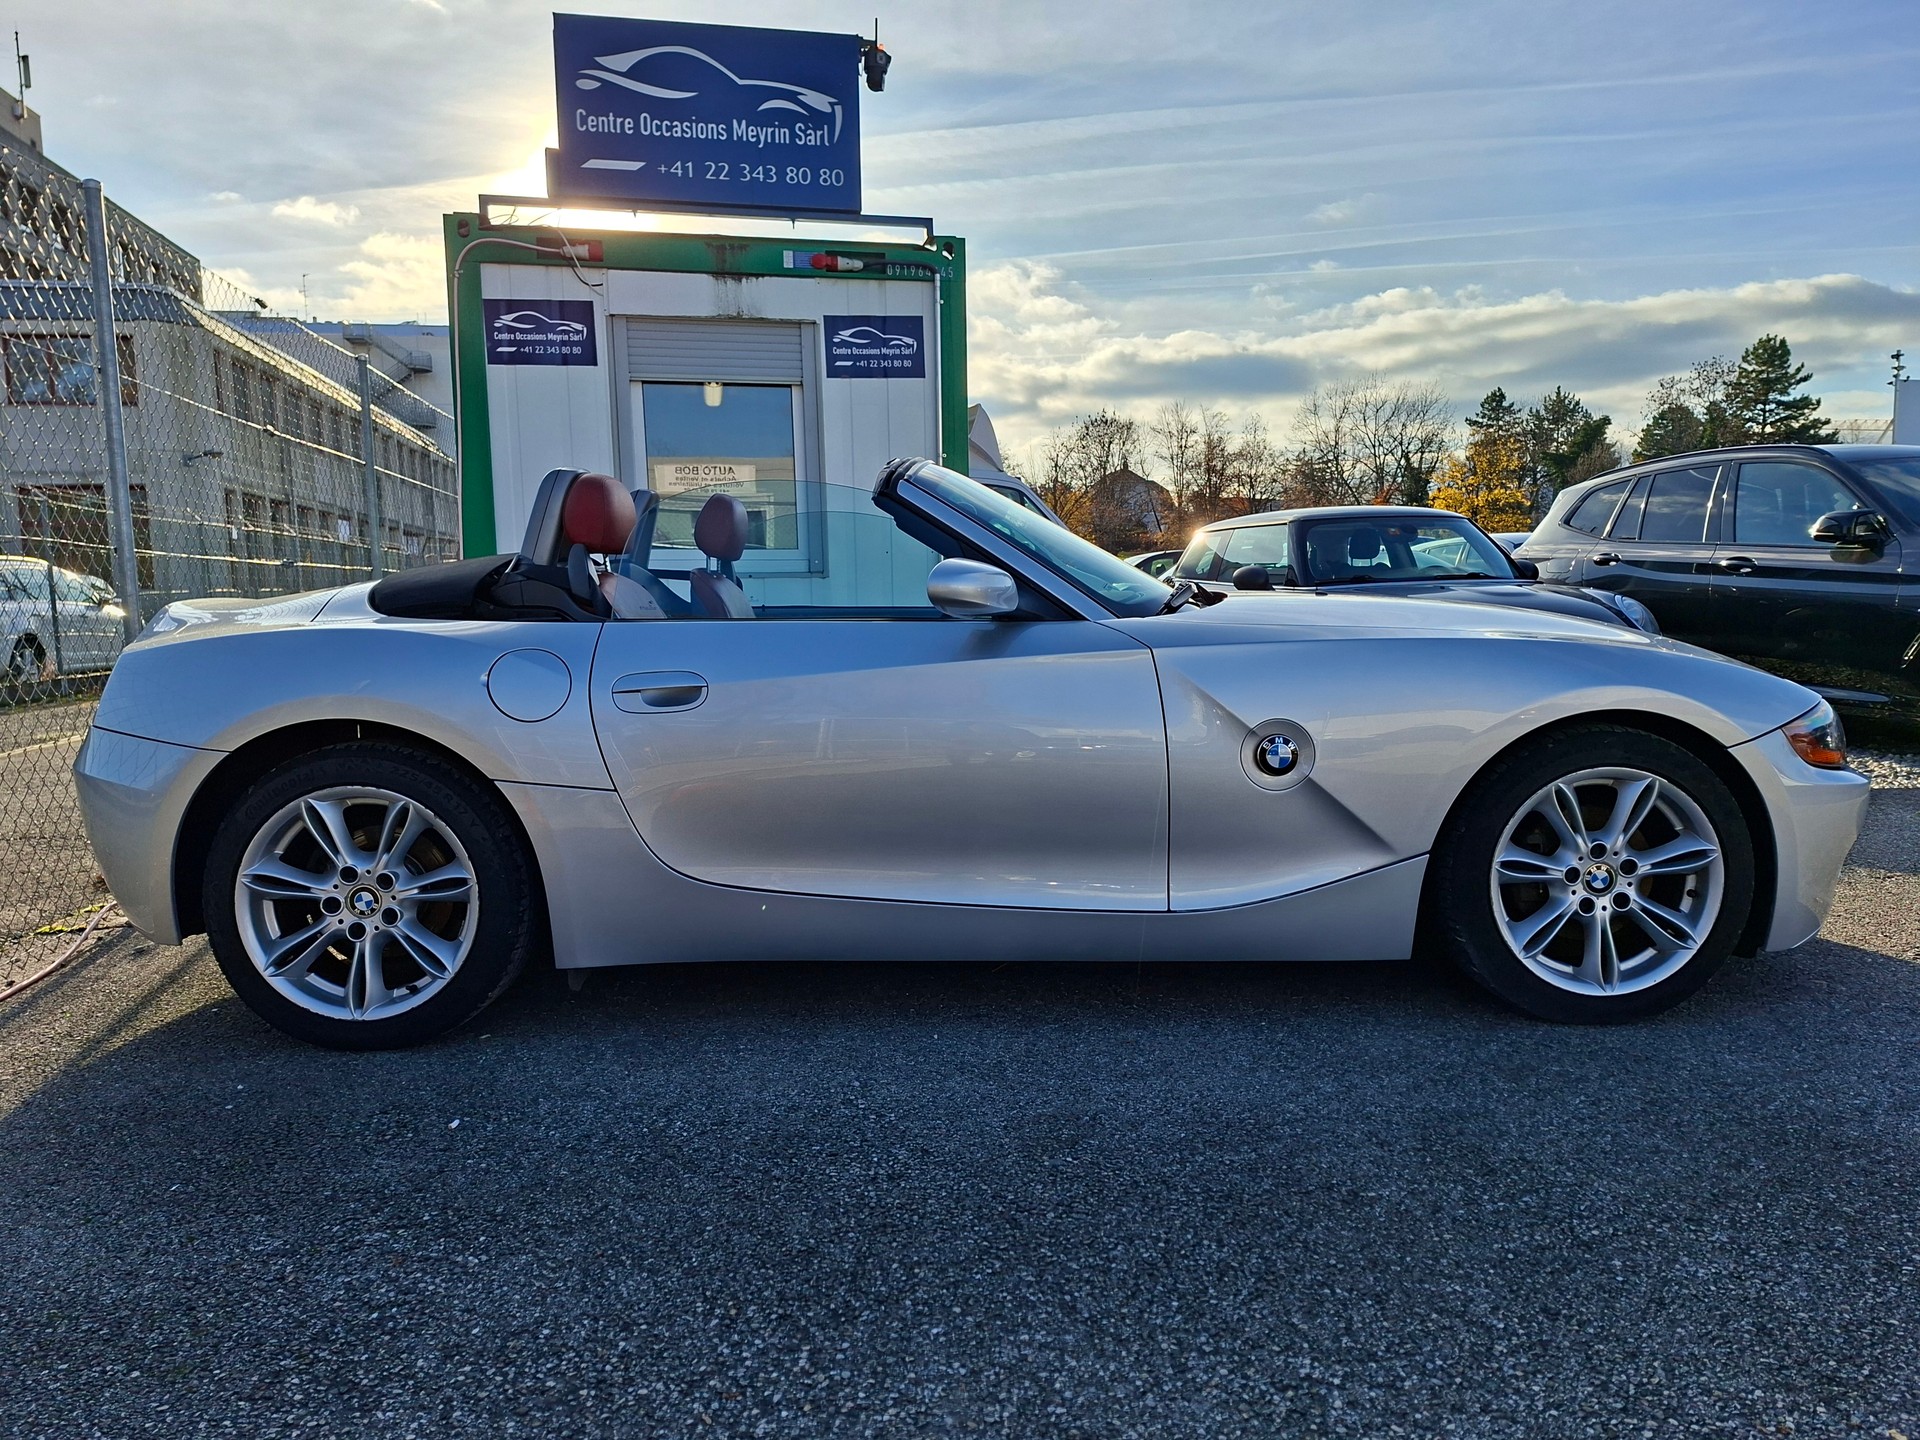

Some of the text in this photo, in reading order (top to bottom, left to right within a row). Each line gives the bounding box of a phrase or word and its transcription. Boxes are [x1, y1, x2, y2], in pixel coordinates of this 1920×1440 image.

[576, 109, 829, 148] Centre Occasions Meyrin Sàrl
[658, 161, 844, 186] +41 22 343 80 80
[887, 264, 953, 277] 09196445
[494, 332, 514, 340] Centre
[516, 332, 546, 340] Occasions
[548, 333, 568, 342] Meyrin
[881, 347, 899, 356] Meyrin
[1263, 737, 1295, 750] BMW
